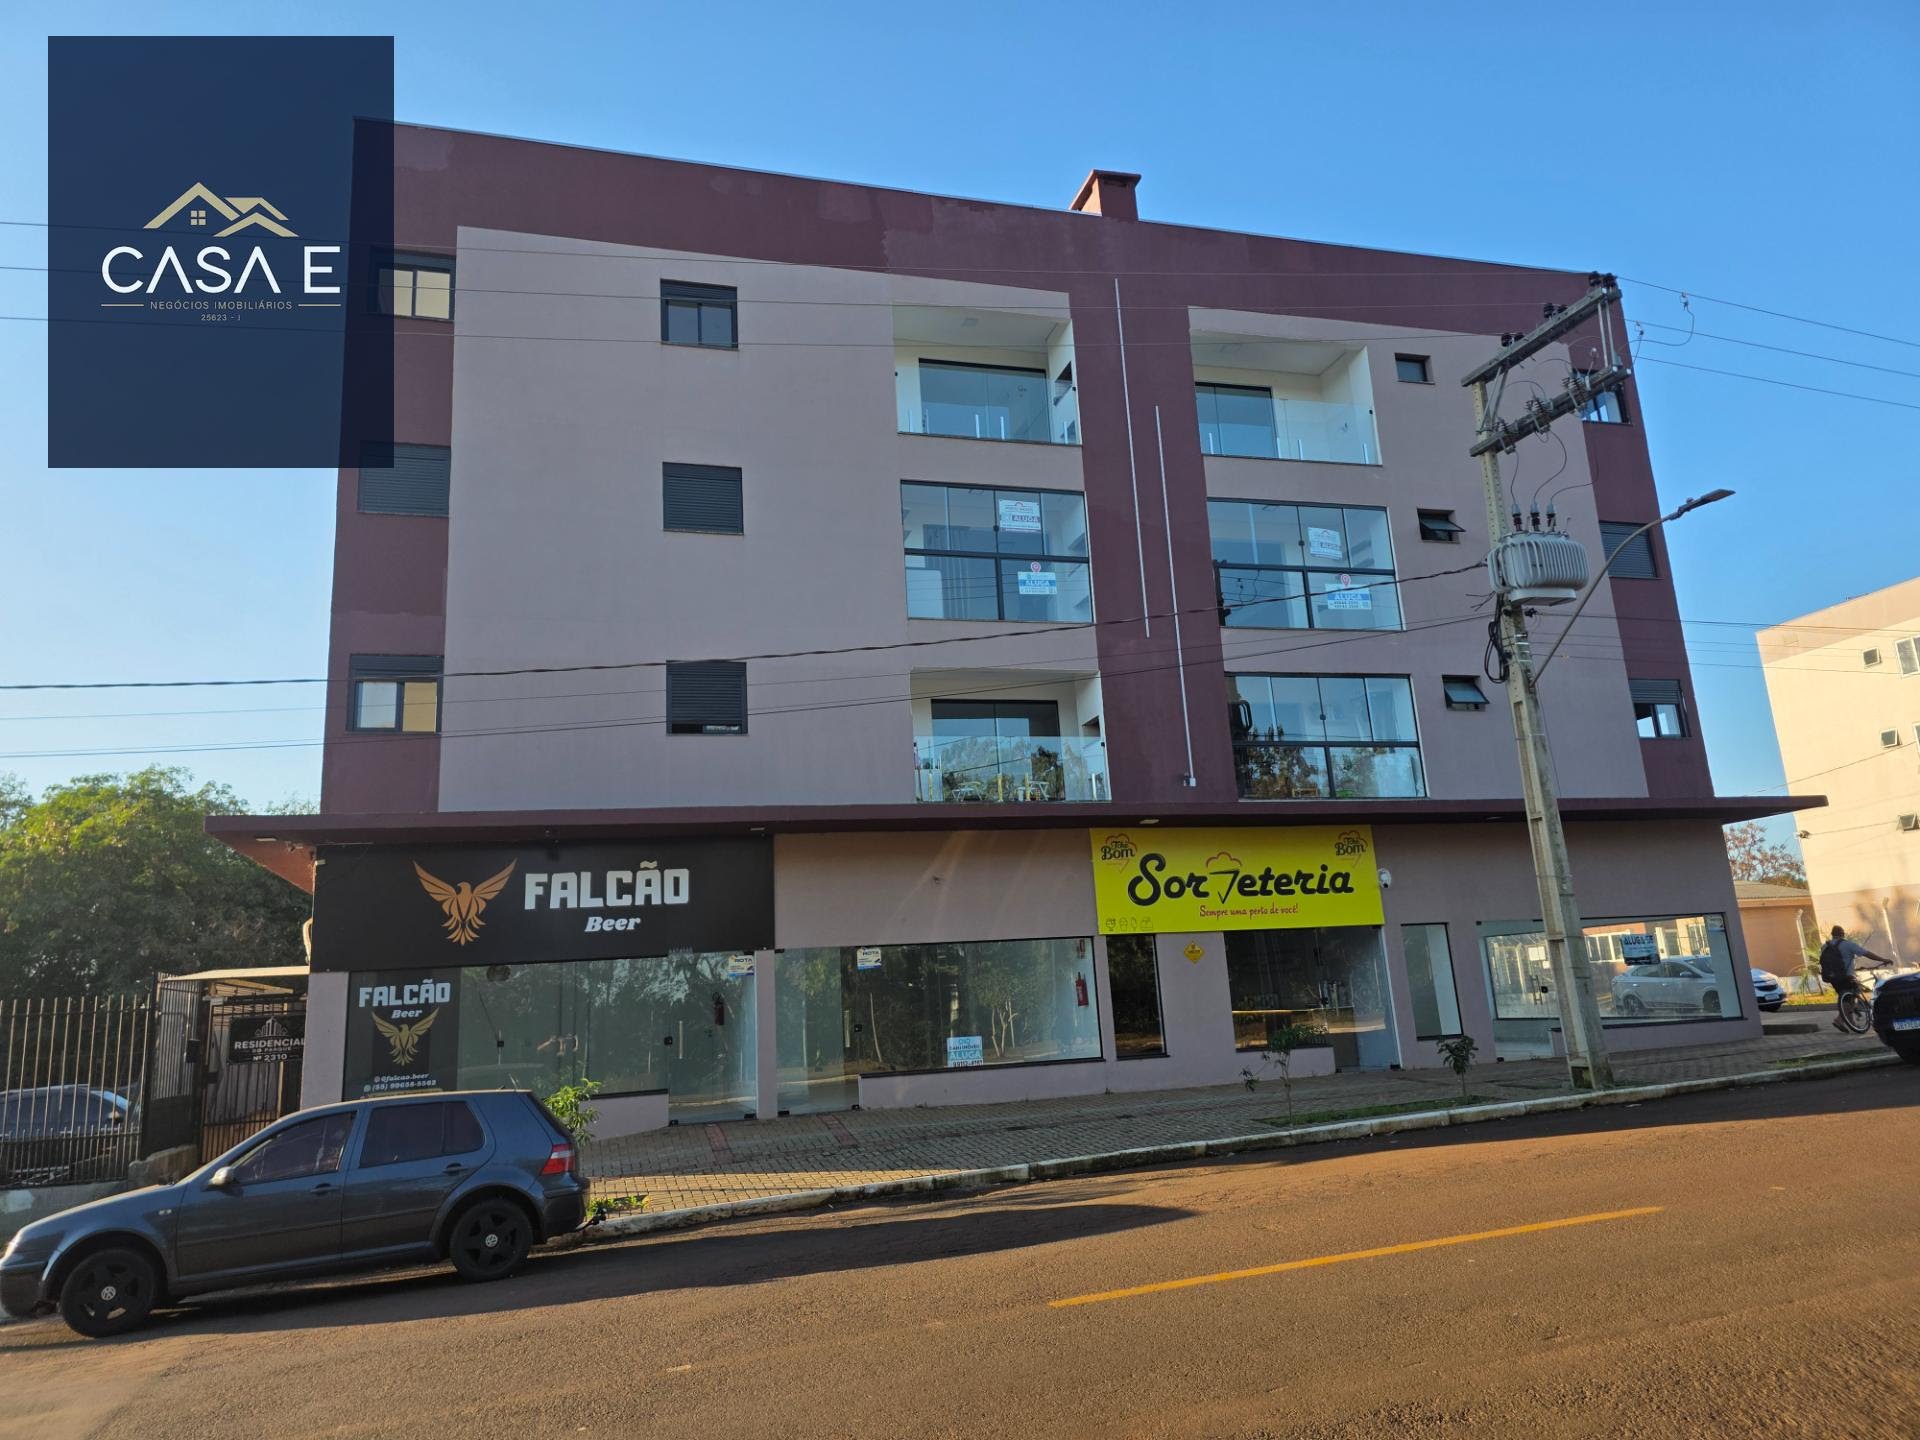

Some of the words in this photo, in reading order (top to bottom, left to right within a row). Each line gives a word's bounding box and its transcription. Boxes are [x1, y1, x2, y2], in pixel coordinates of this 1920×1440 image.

[524, 860, 690, 910] FALCÃO
[1200, 904, 1229, 920] Sempre
[1230, 908, 1248, 916] uma
[1269, 901, 1279, 915] de
[584, 916, 641, 933] Beer
[358, 978, 451, 1008] FALCÃO
[391, 1008, 423, 1019] Beer
[234, 1038, 305, 1049] RESIDENCIAL
[264, 1053, 288, 1061] 2310
